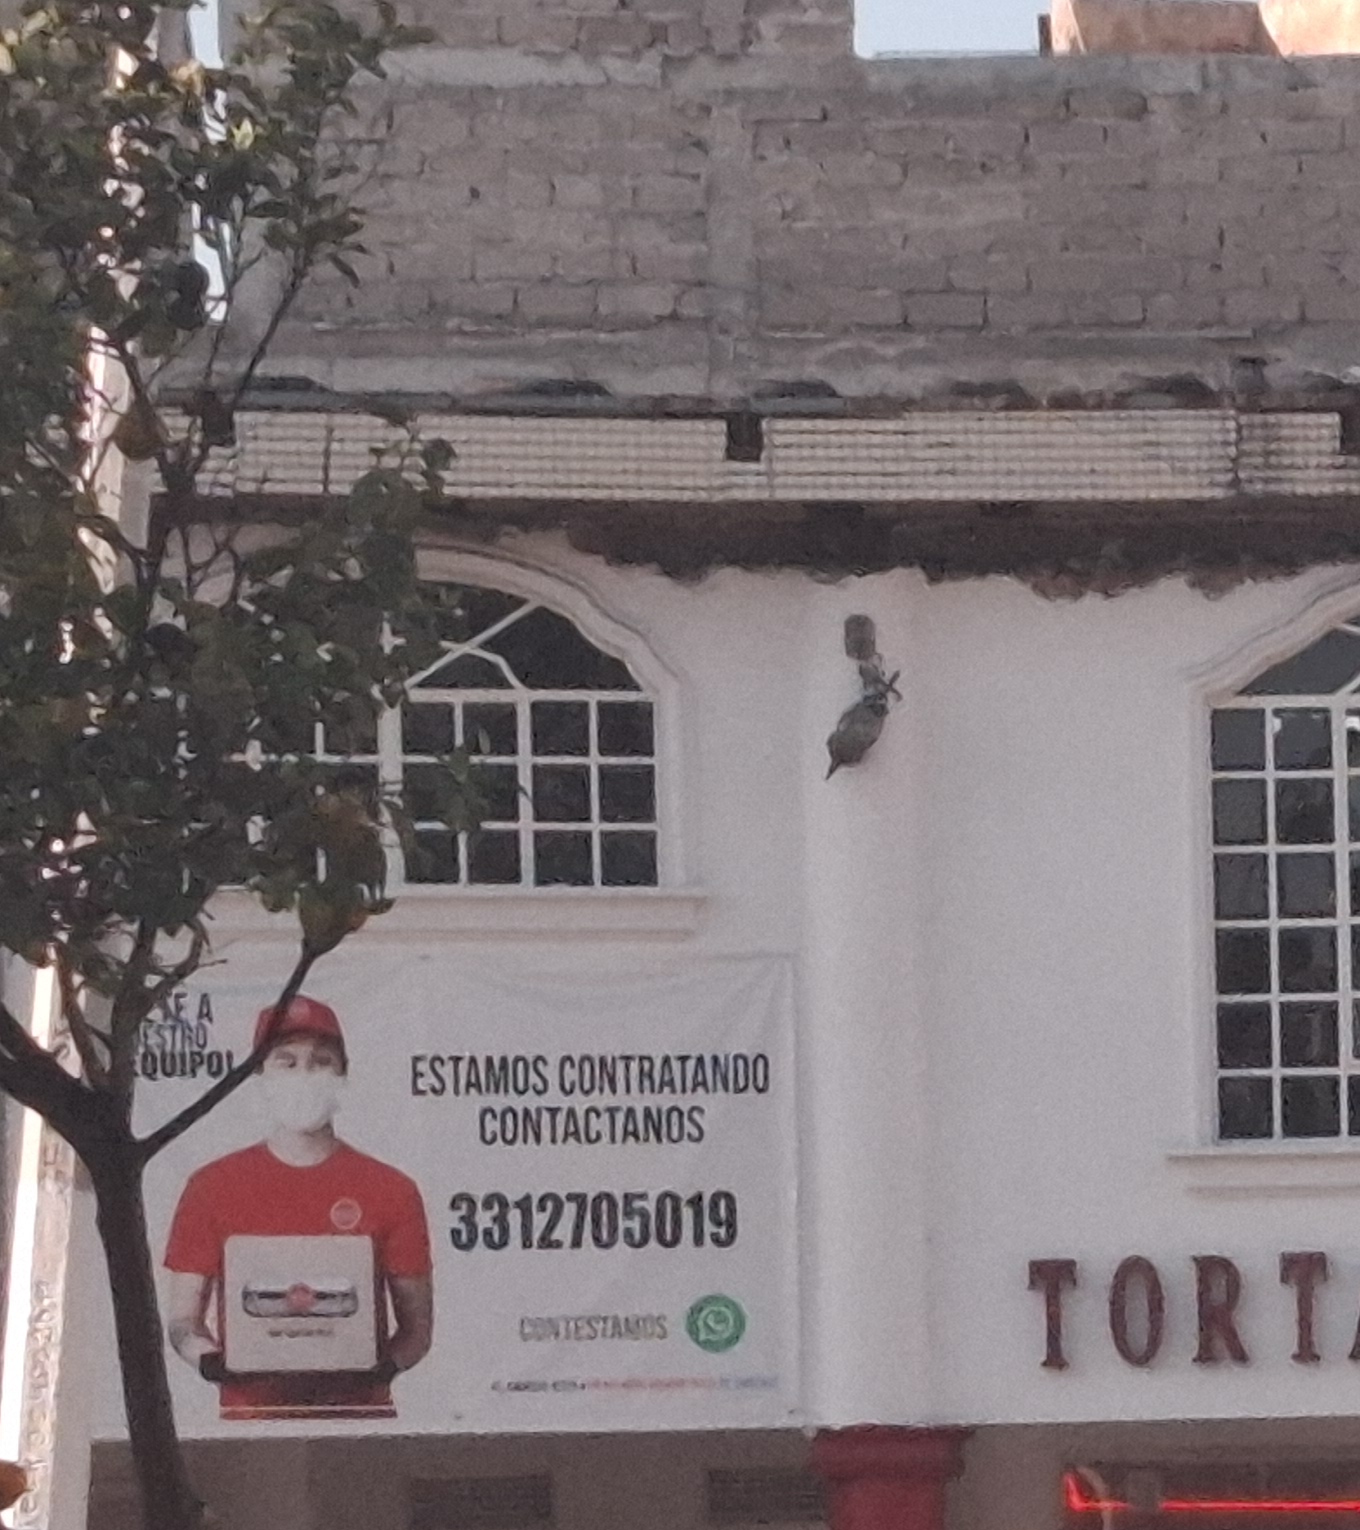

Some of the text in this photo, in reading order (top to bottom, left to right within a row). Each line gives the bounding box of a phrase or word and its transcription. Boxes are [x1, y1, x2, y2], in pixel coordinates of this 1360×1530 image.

[411, 1052, 771, 1097] ESTAMOS CONTRATANDO
[478, 1104, 706, 1147] CONTACTANOS
[449, 1189, 739, 1251] 3312705019
[518, 1314, 669, 1342] CONTESTAMOS
